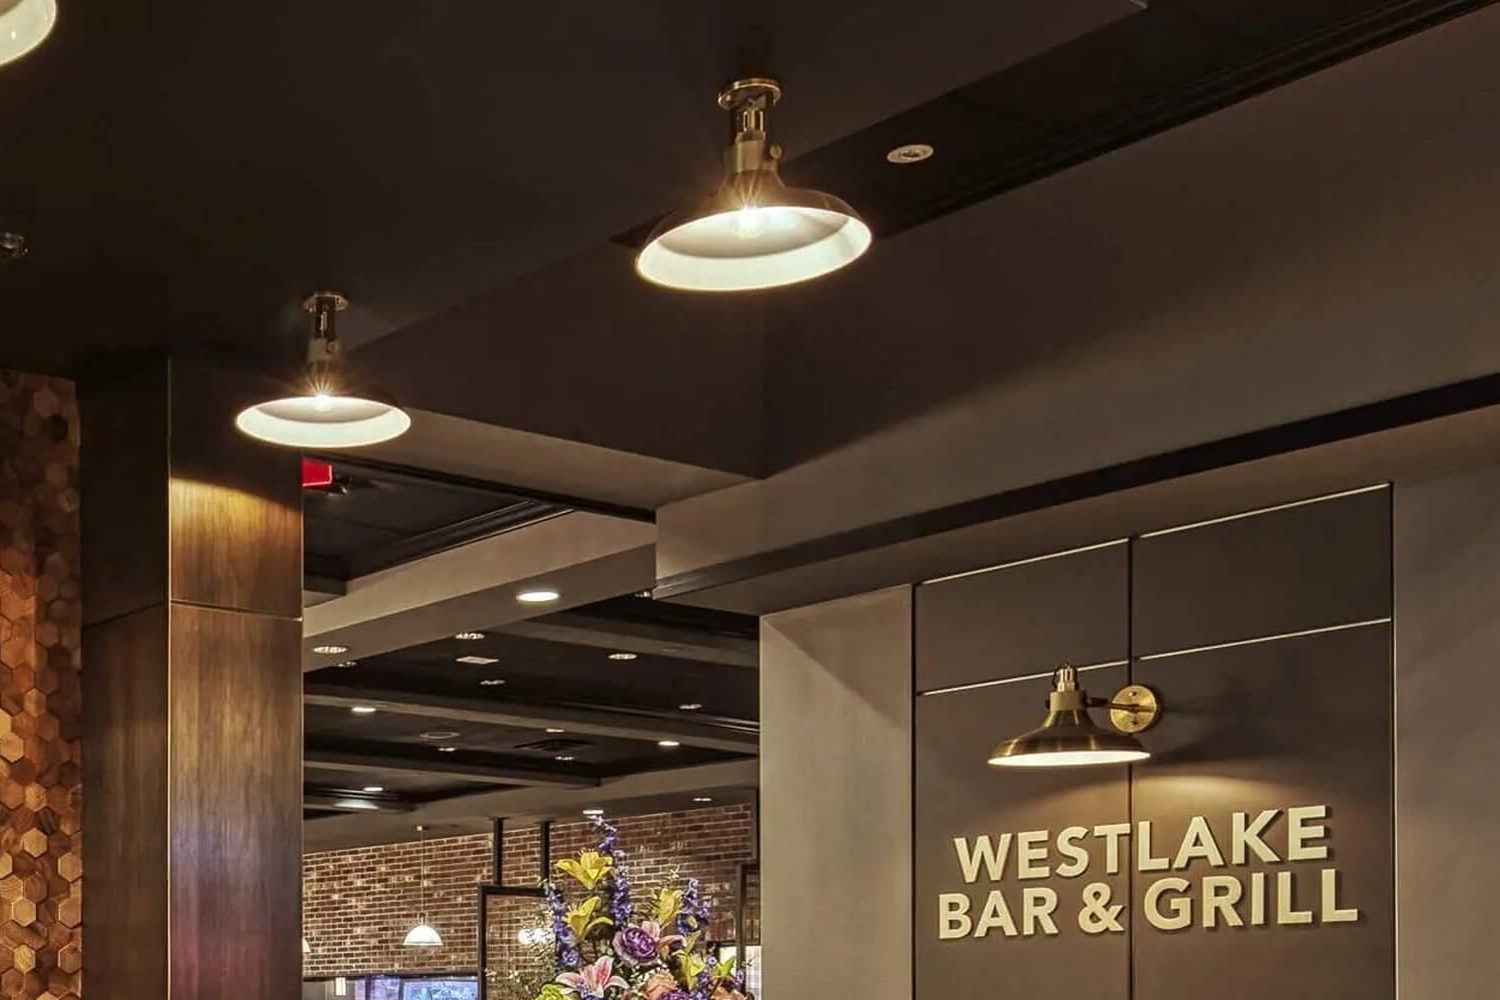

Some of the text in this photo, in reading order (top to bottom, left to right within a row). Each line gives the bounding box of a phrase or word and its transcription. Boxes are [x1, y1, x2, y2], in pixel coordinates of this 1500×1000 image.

[954, 805, 1329, 883] WESTLAKE
[938, 869, 1358, 939] BAR & GRILL
